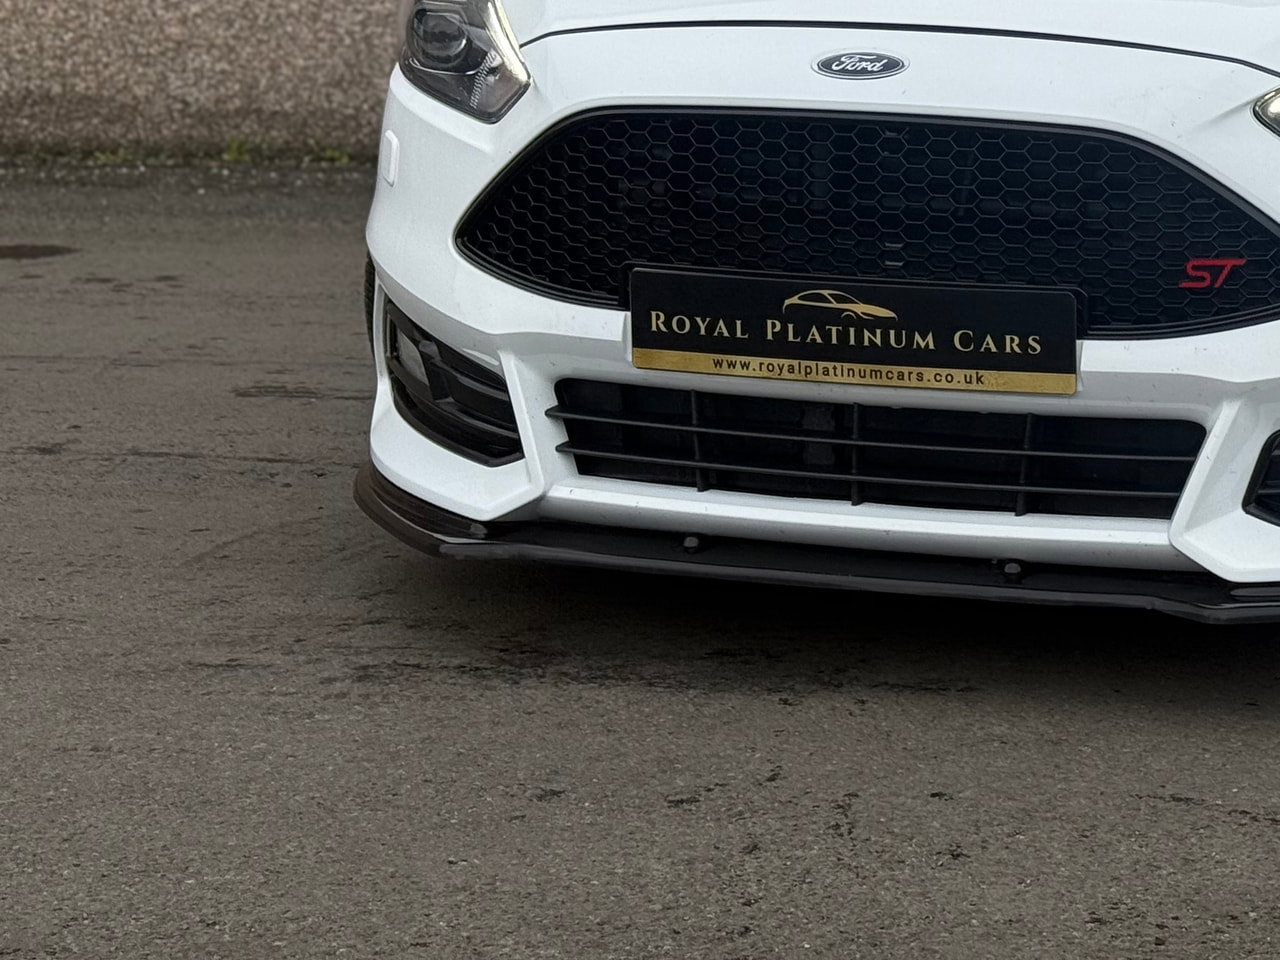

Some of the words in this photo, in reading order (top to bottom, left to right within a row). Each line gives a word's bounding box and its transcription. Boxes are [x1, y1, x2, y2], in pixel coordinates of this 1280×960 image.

[831, 54, 888, 72] Ford
[1178, 258, 1248, 288] ST
[650, 310, 750, 339] ROYAL
[766, 319, 937, 351] PLATINUM
[953, 329, 1042, 355] CARS
[712, 357, 985, 386] www.royalplatinumcars.co.uk
